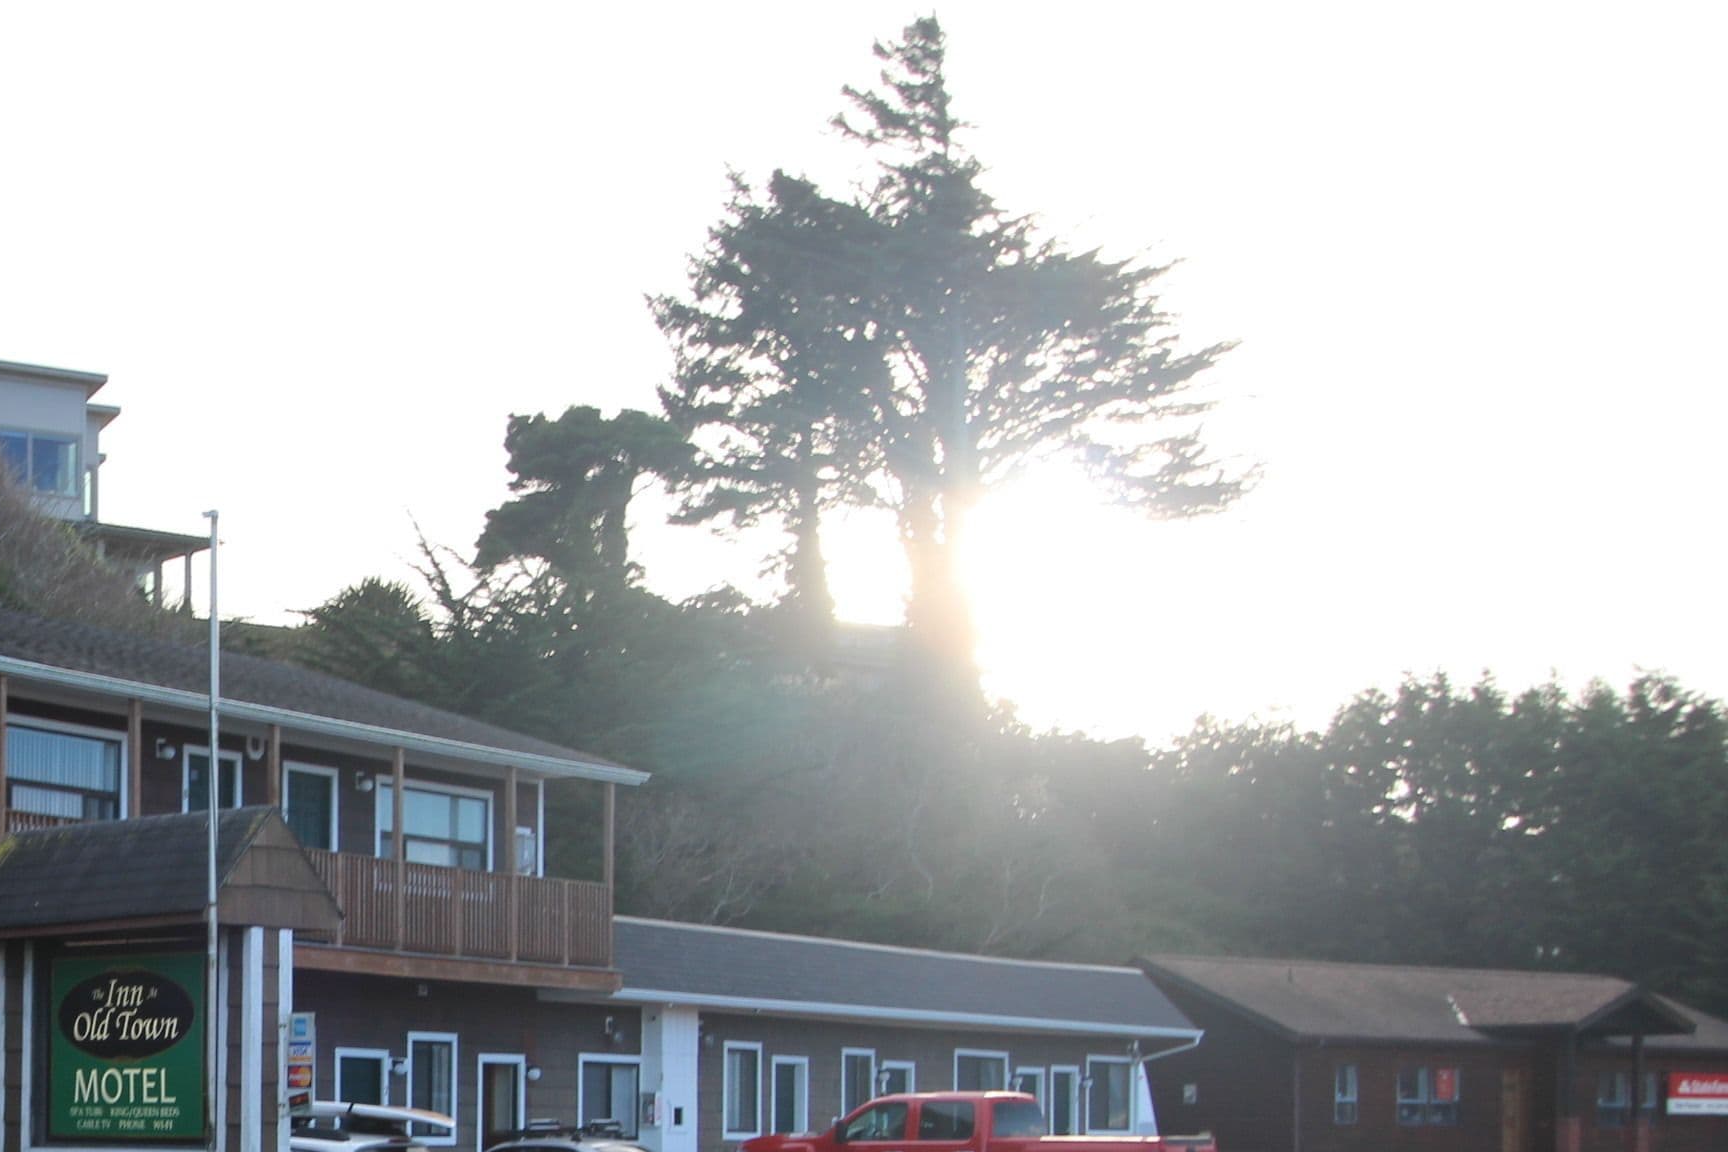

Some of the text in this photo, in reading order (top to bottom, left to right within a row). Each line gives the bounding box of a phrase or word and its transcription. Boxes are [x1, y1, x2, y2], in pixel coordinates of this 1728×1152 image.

[104, 979, 143, 1007] Inn
[73, 1007, 179, 1041] Old Town
[74, 1067, 177, 1104] MOTEL
[118, 1119, 146, 1130] PHONE
